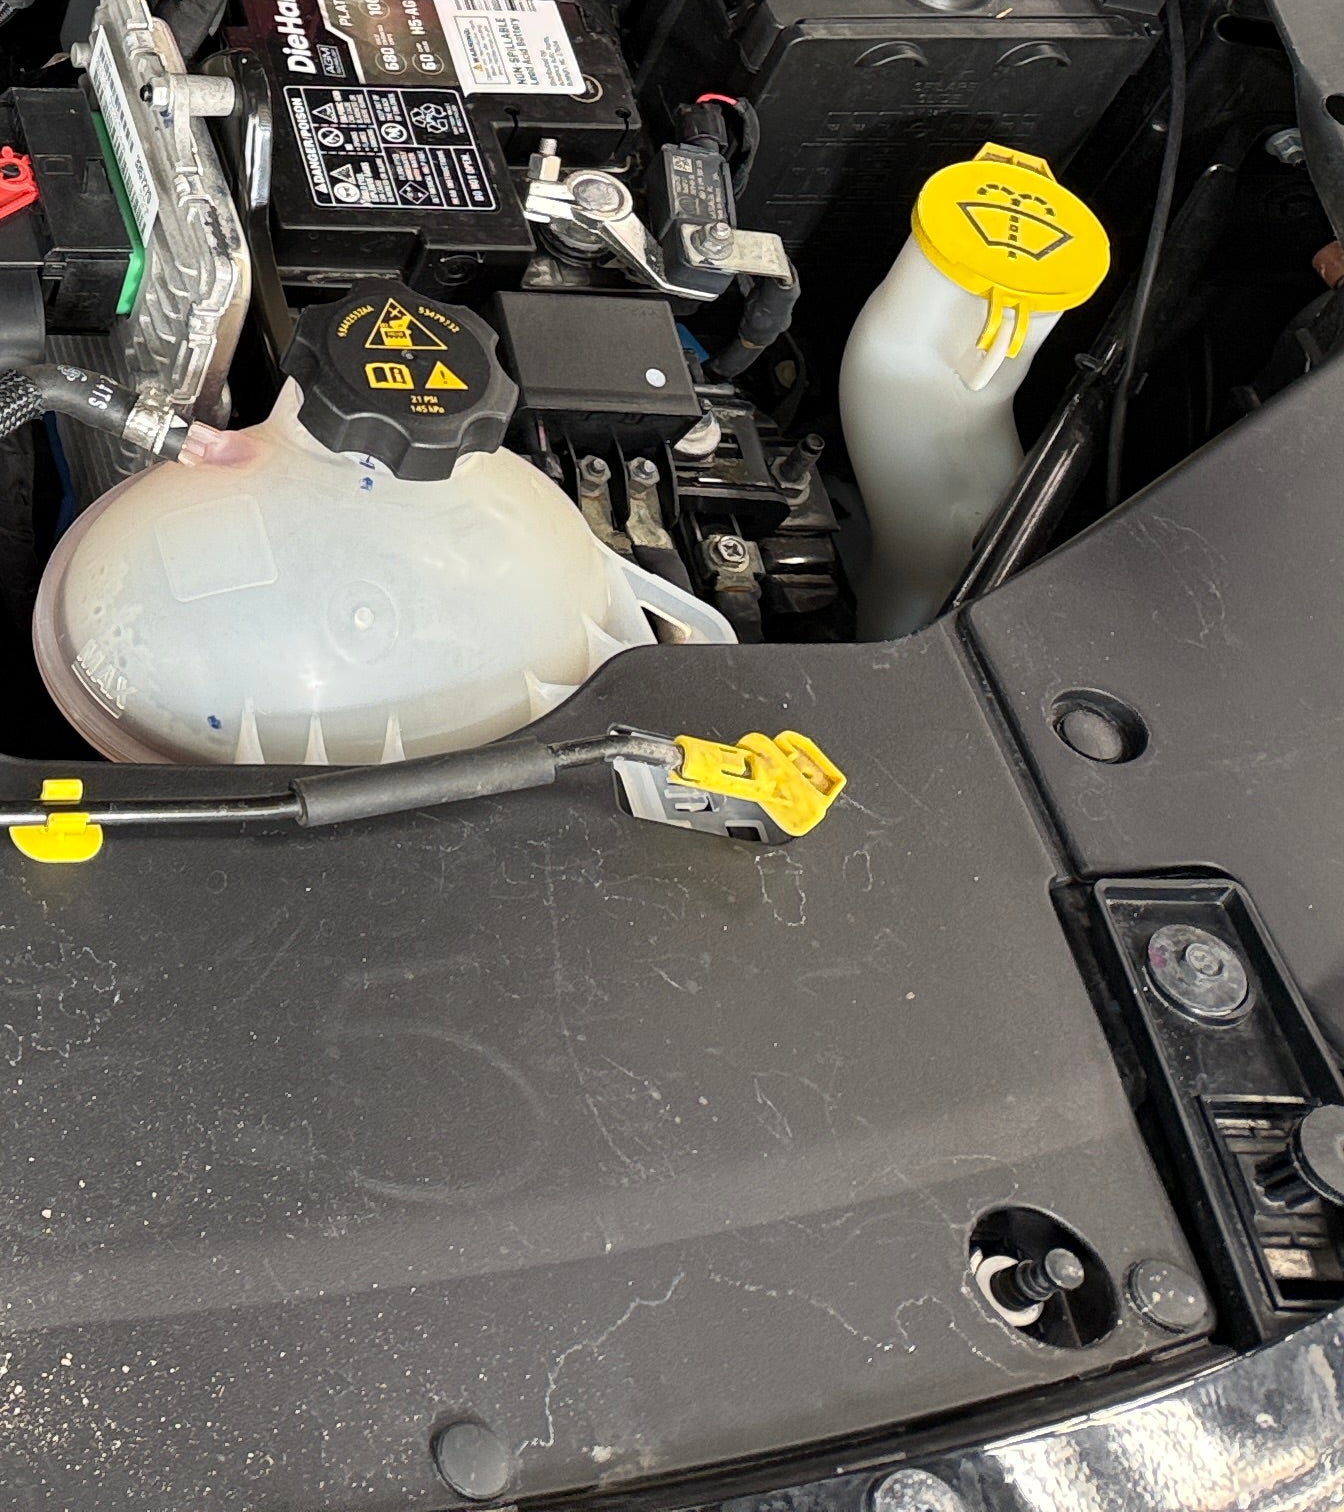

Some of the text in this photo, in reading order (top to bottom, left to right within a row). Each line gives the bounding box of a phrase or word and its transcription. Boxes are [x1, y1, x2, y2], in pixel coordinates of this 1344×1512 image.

[321, 47, 336, 74] AGM
[381, 47, 400, 71] 680
[419, 54, 436, 71] 60
[495, 17, 527, 85] NON-SPILLABLE
[510, 18, 540, 86] Lead Acid Battery
[291, 97, 327, 184] DANGER/POISON
[466, 175, 481, 191] NOT
[472, 191, 485, 202] DO
[410, 404, 427, 414] 145
[76, 638, 138, 710] MAX
